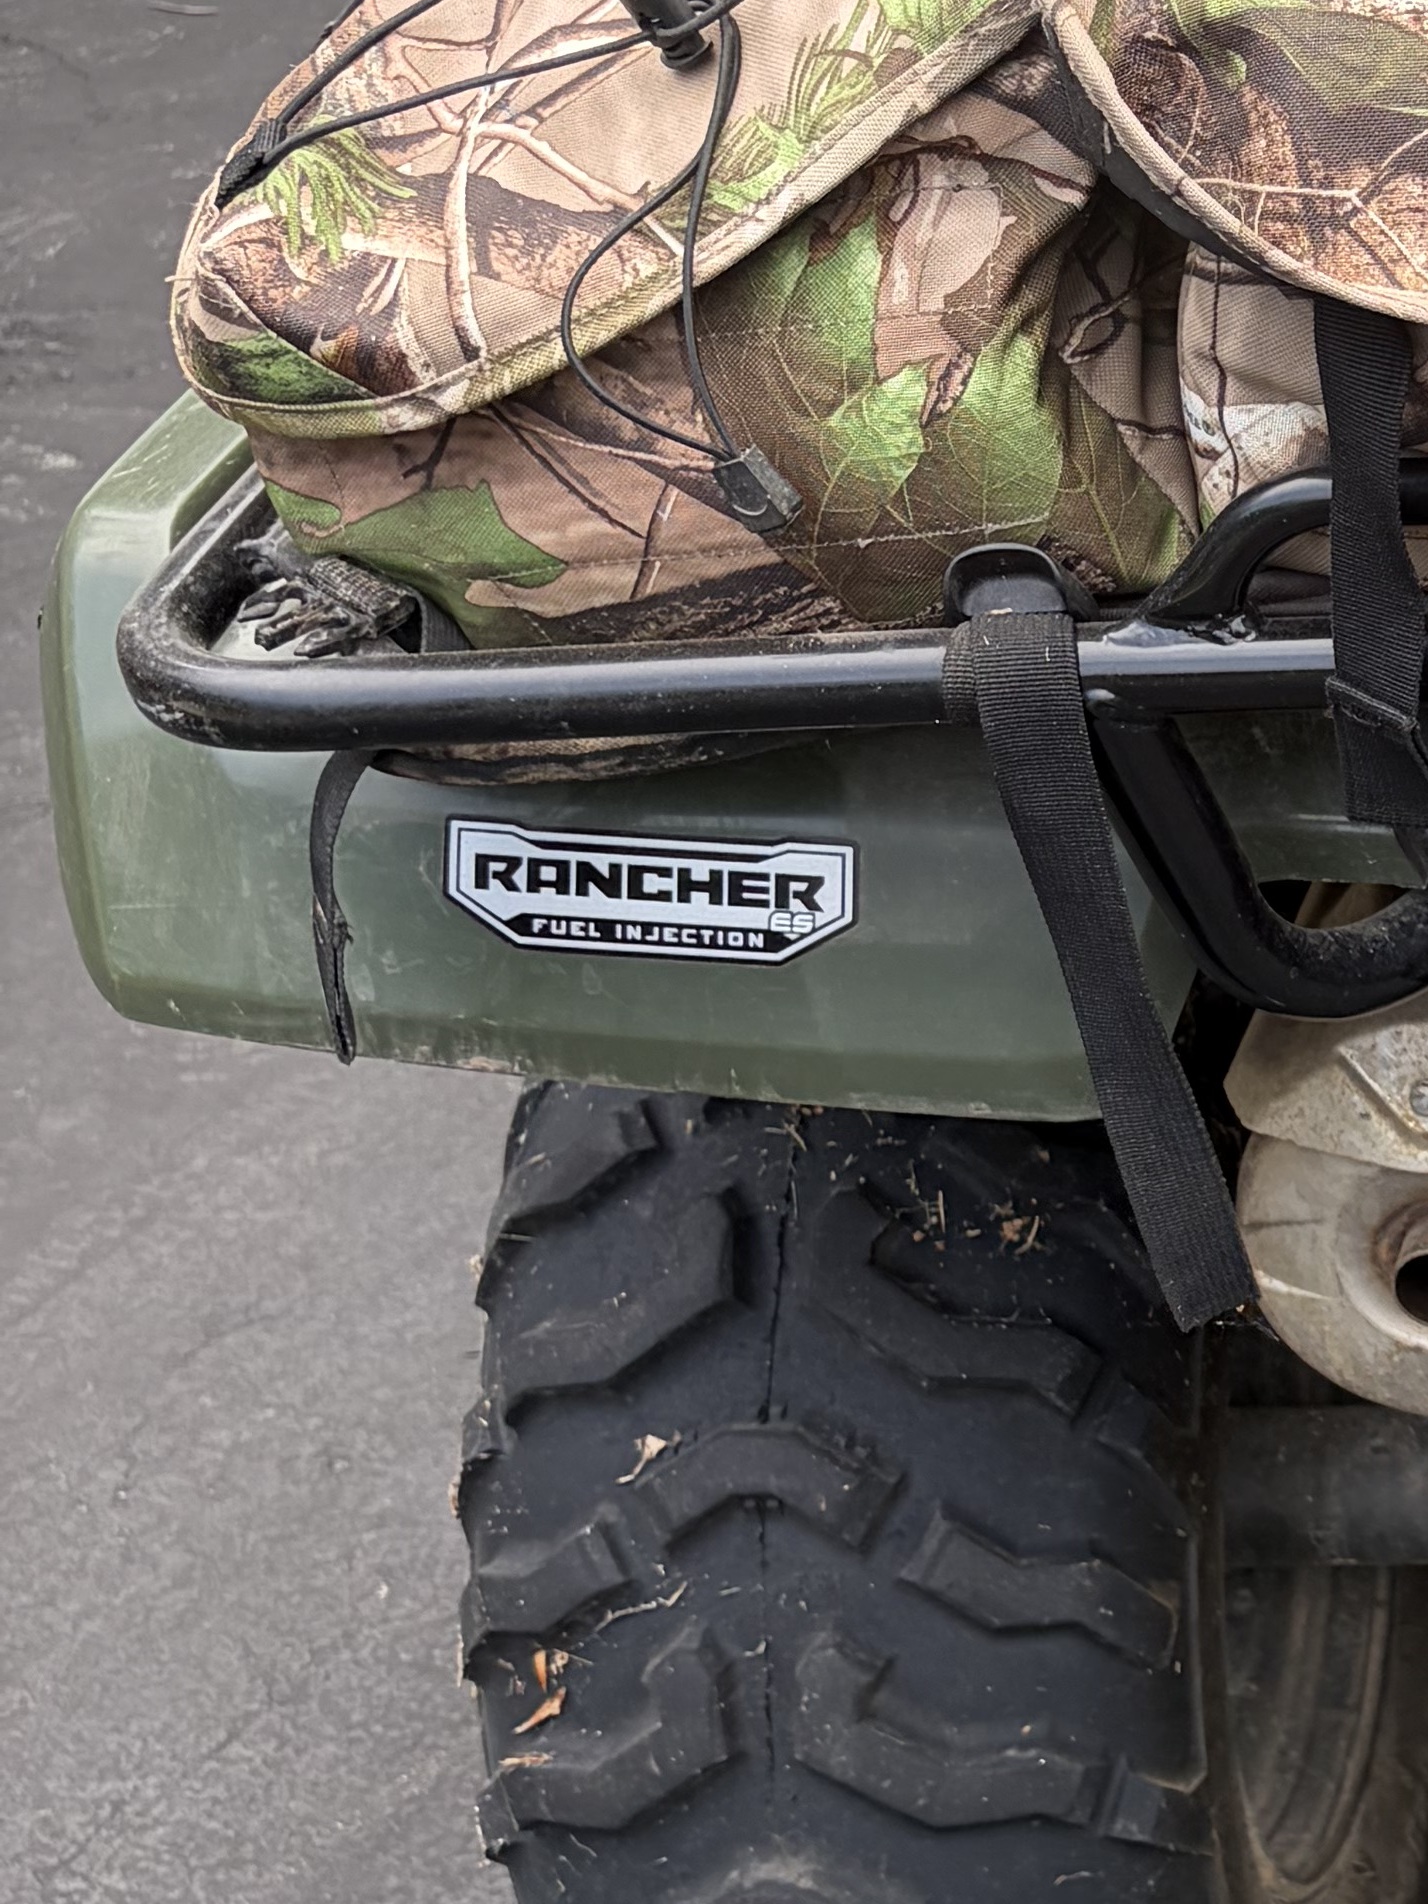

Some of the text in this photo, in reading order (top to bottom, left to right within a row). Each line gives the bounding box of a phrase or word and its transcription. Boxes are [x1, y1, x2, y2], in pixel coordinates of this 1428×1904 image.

[474, 852, 826, 913] RANCHER
[531, 917, 766, 949] FUEL INJECTION
[769, 911, 815, 934] ES
